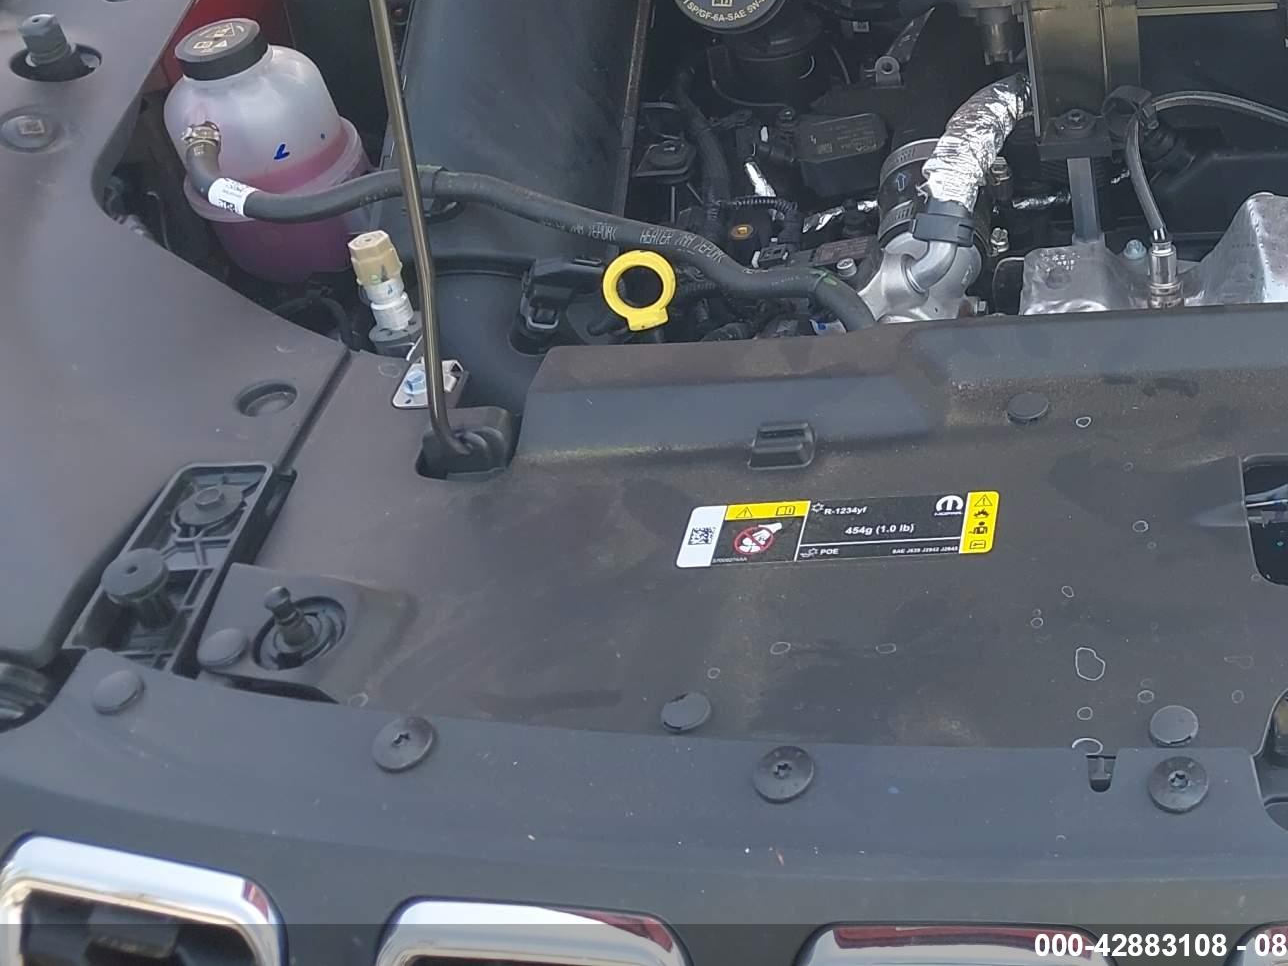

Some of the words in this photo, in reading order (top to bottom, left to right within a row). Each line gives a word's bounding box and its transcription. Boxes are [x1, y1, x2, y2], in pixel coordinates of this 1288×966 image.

[823, 506, 868, 516] R-1234yf
[845, 525, 873, 536] 454g
[875, 524, 897, 535] (1.0
[899, 523, 915, 533] lb)
